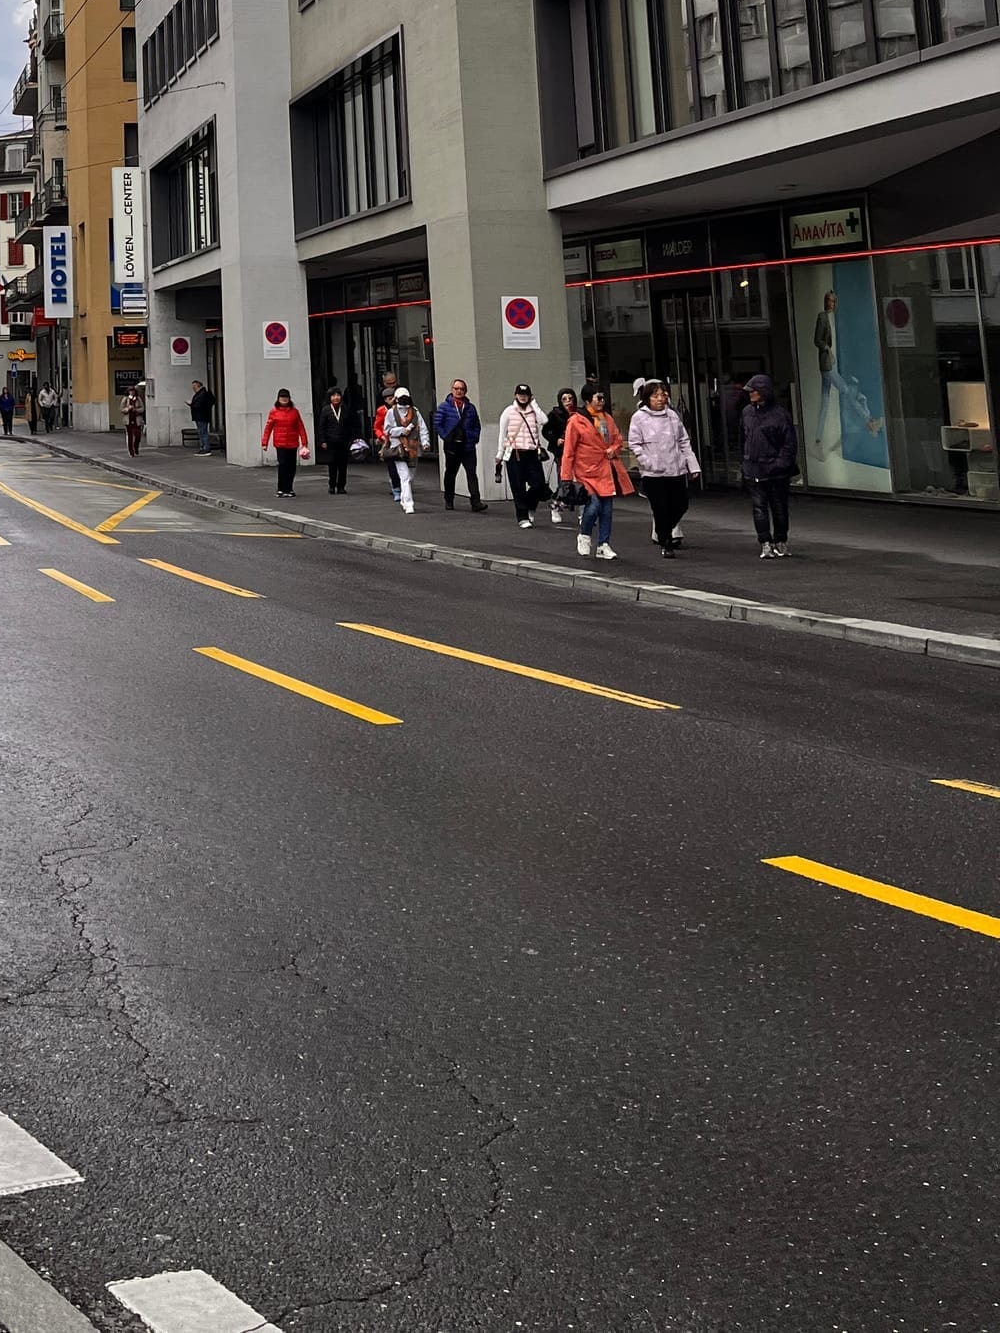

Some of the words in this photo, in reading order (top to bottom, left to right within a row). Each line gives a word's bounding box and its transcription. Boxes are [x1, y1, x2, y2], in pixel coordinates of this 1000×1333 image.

[123, 172, 133, 215] CENTER
[50, 232, 67, 304] HOTEL
[125, 237, 135, 278] LÖWEN
